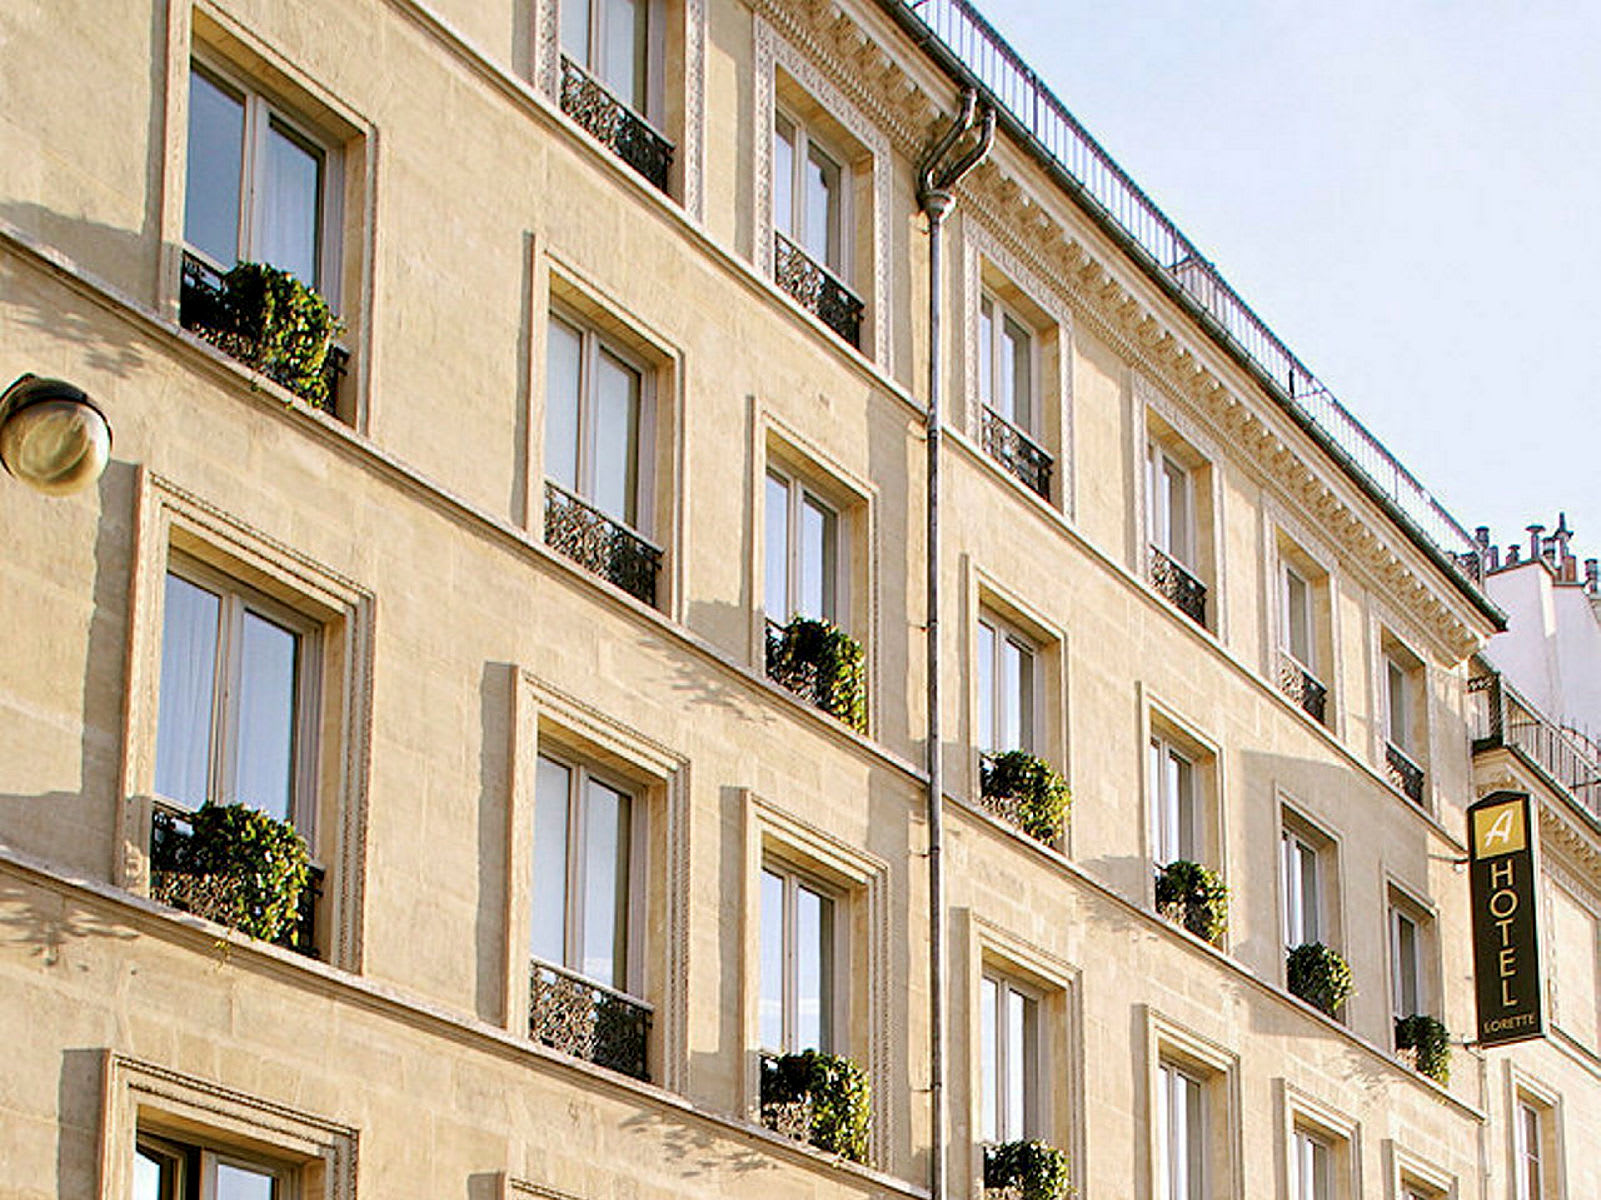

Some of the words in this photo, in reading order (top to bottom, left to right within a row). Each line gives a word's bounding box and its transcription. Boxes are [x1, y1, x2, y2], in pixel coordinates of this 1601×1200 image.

[1485, 809, 1513, 847] A
[1489, 858, 1518, 1007] HOTEL
[1484, 1013, 1535, 1034] LORETTE
